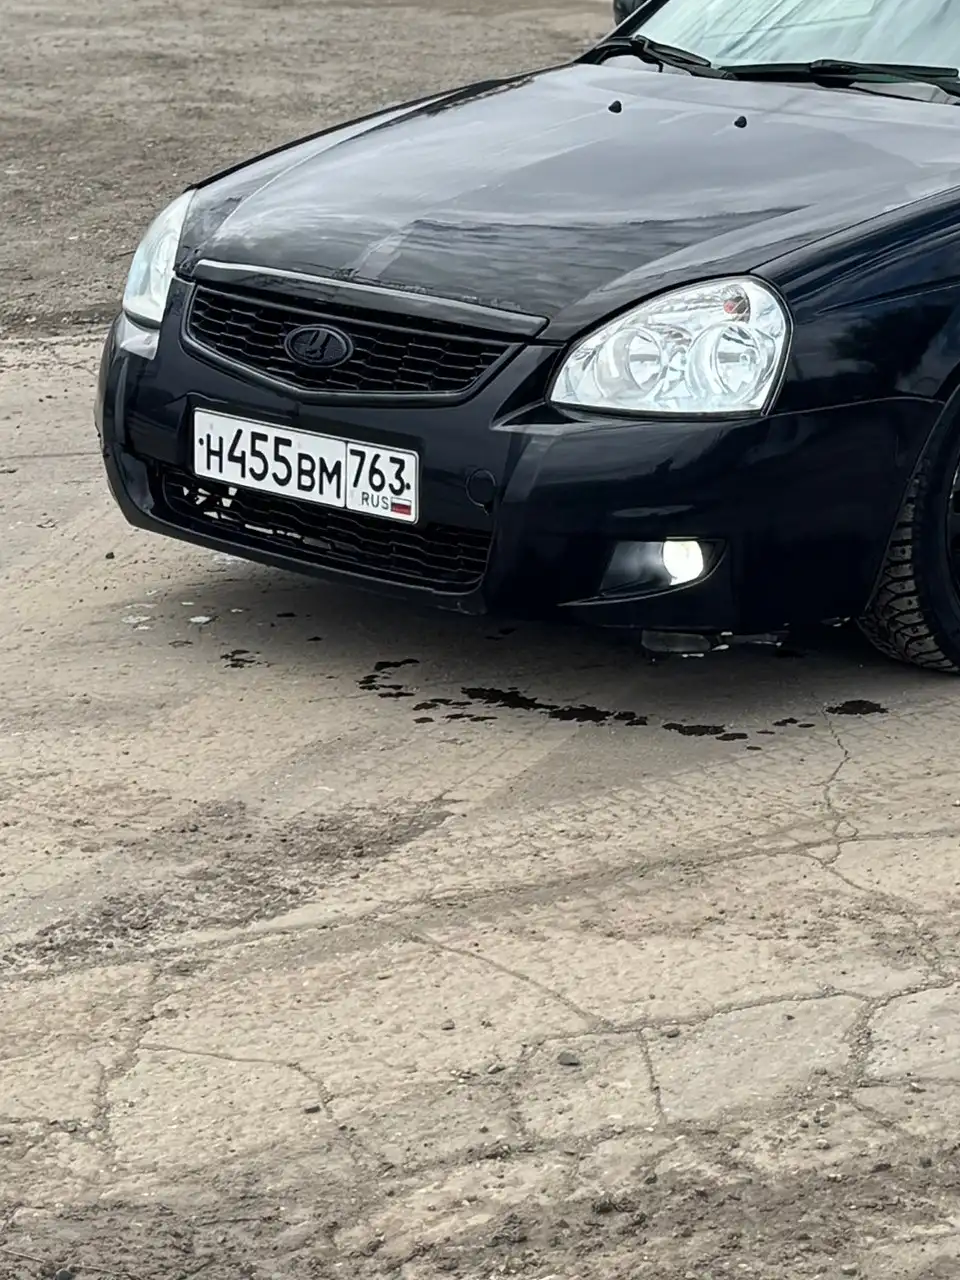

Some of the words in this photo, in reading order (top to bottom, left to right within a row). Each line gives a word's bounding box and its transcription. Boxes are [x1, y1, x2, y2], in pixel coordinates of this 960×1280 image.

[206, 428, 342, 499] Н455ВМ
[350, 449, 406, 497] 763
[361, 491, 389, 510] RUS
